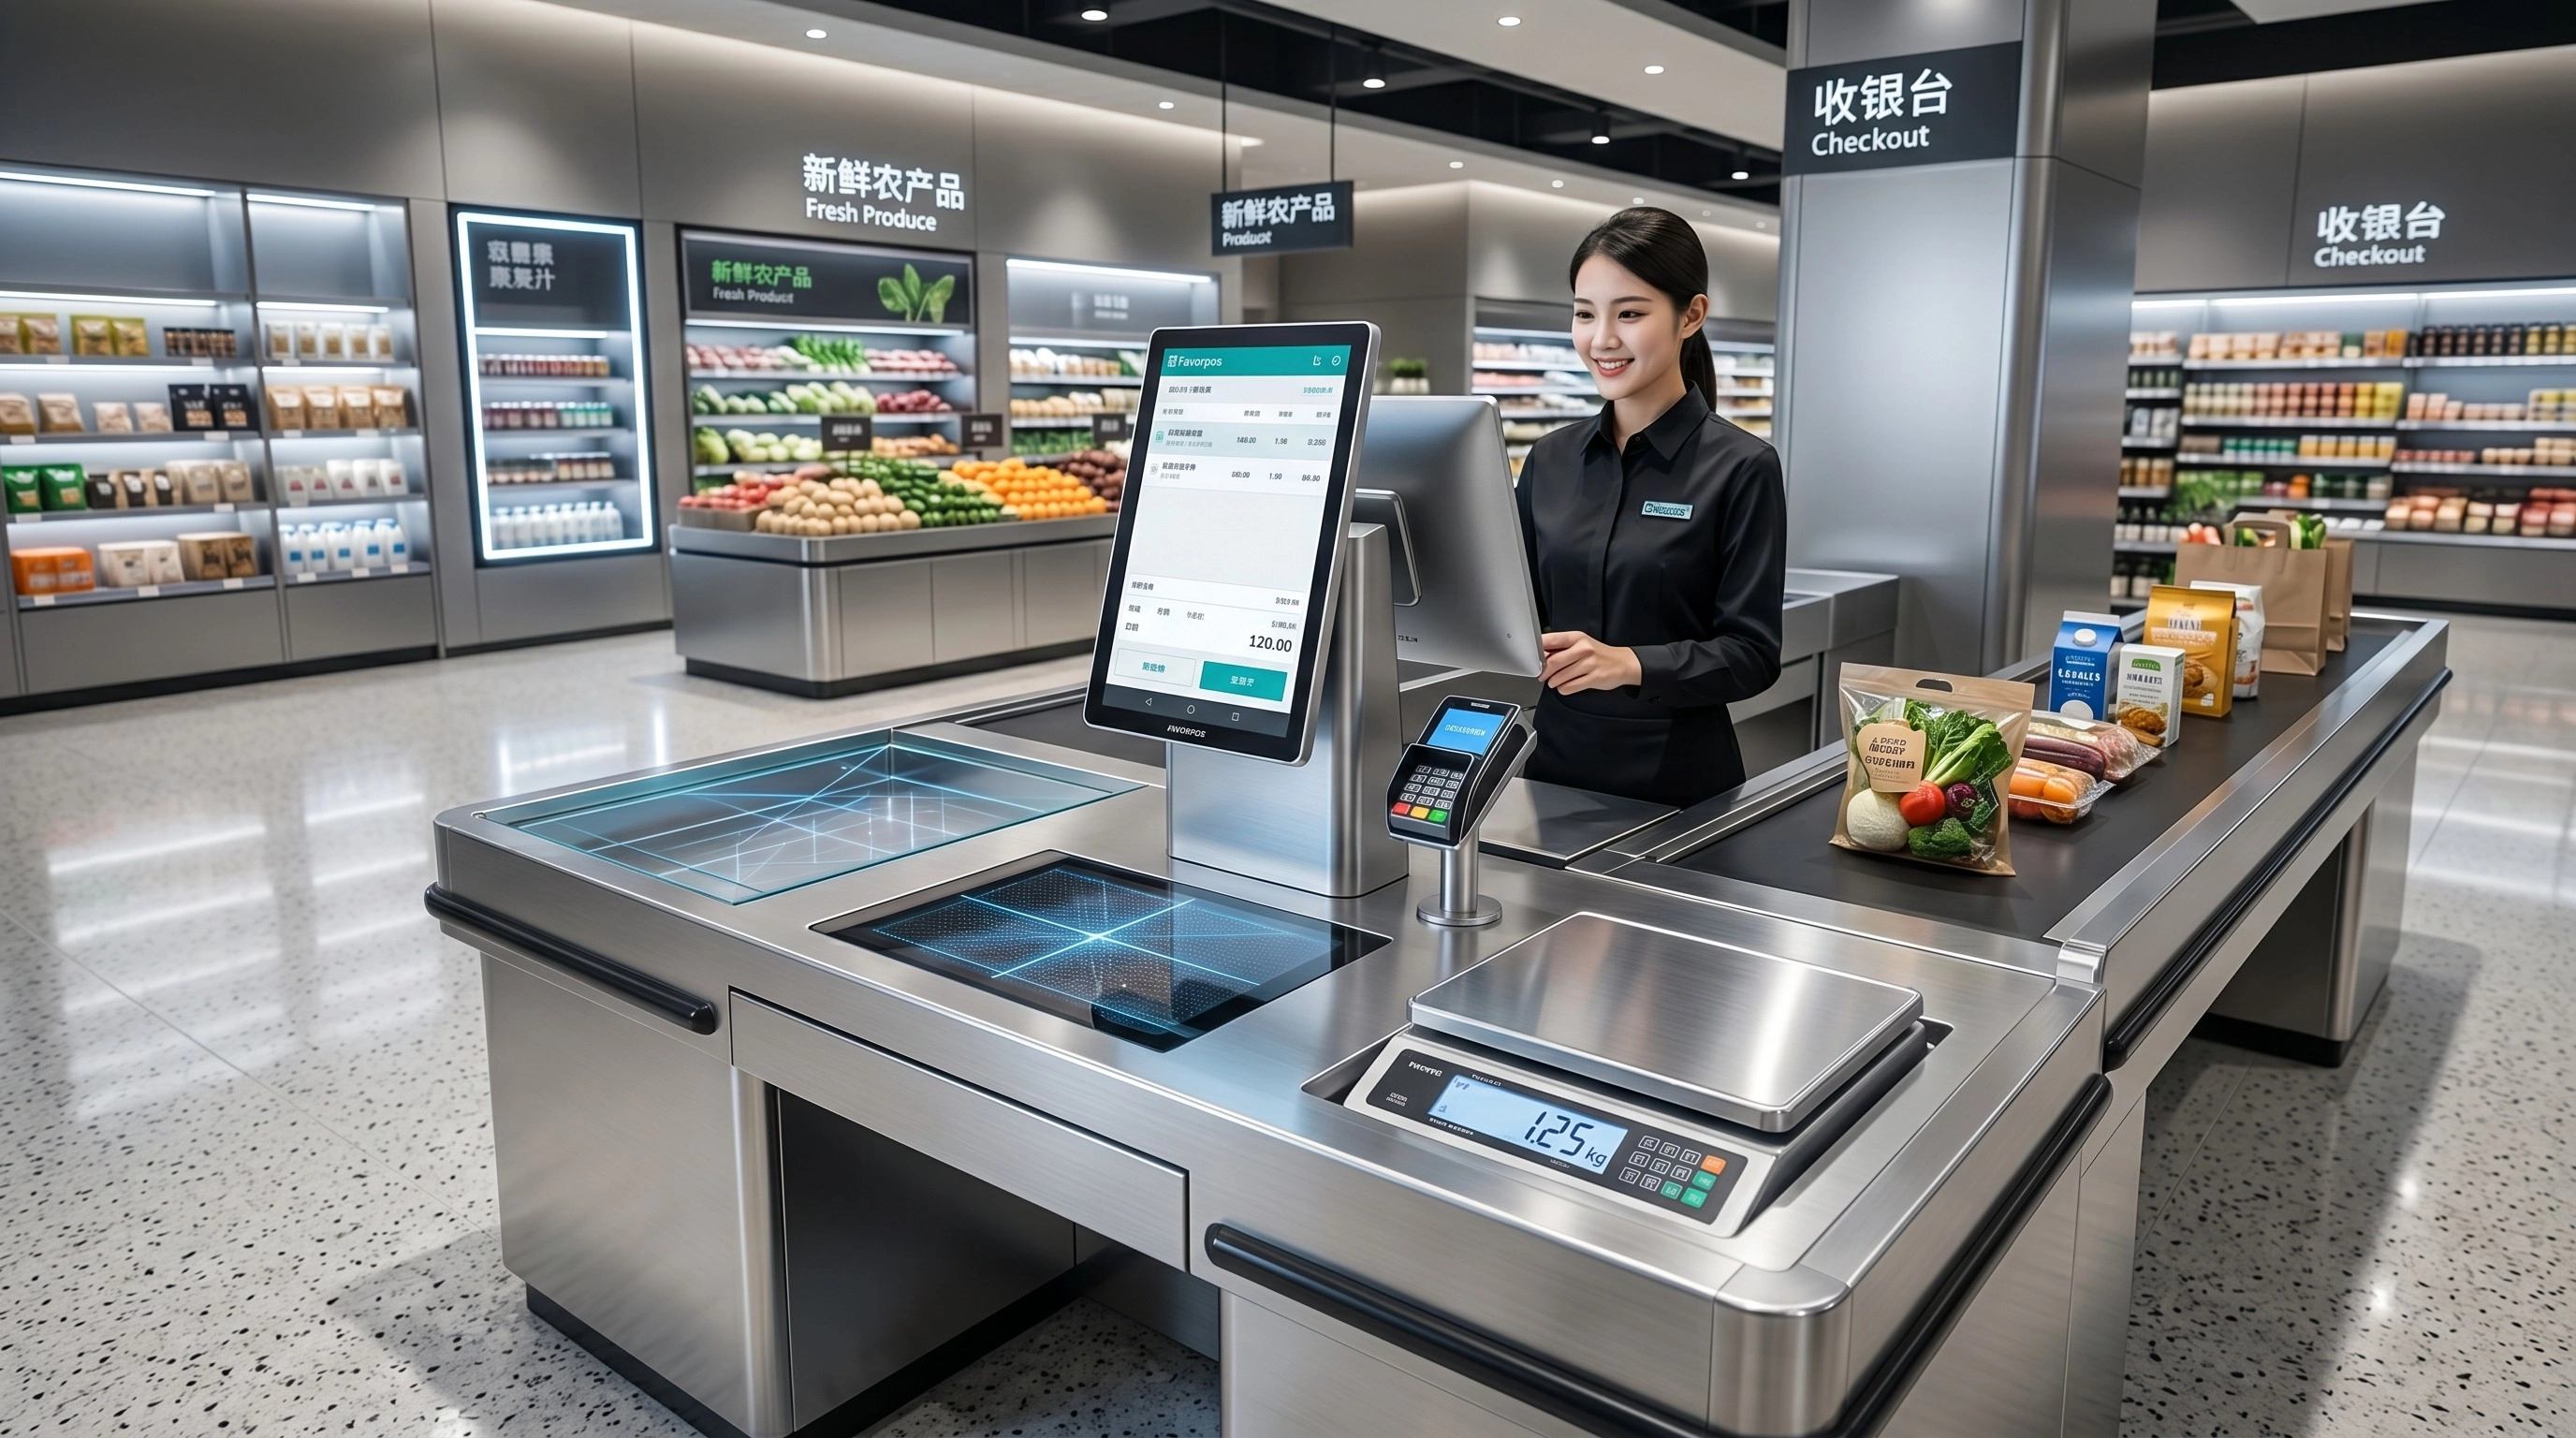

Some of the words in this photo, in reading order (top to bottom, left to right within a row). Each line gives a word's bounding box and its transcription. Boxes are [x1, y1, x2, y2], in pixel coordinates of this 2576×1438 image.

[1814, 67, 1953, 126] 收银台
[1811, 125, 1930, 156] Checkout
[802, 153, 965, 211] 新鲜农产品
[805, 197, 858, 224] Fresh
[862, 204, 937, 231] Produce
[1222, 192, 1335, 229] 新鲜农产品
[2316, 200, 2446, 244] 收银台
[2313, 243, 2426, 268] Checkout
[710, 258, 812, 289] 新鲜农产品
[1178, 355, 1222, 369] Favorpos
[1249, 634, 1293, 653] 120.00
[1524, 1111, 1594, 1156] 1.25
[1585, 1147, 1608, 1167] kg
